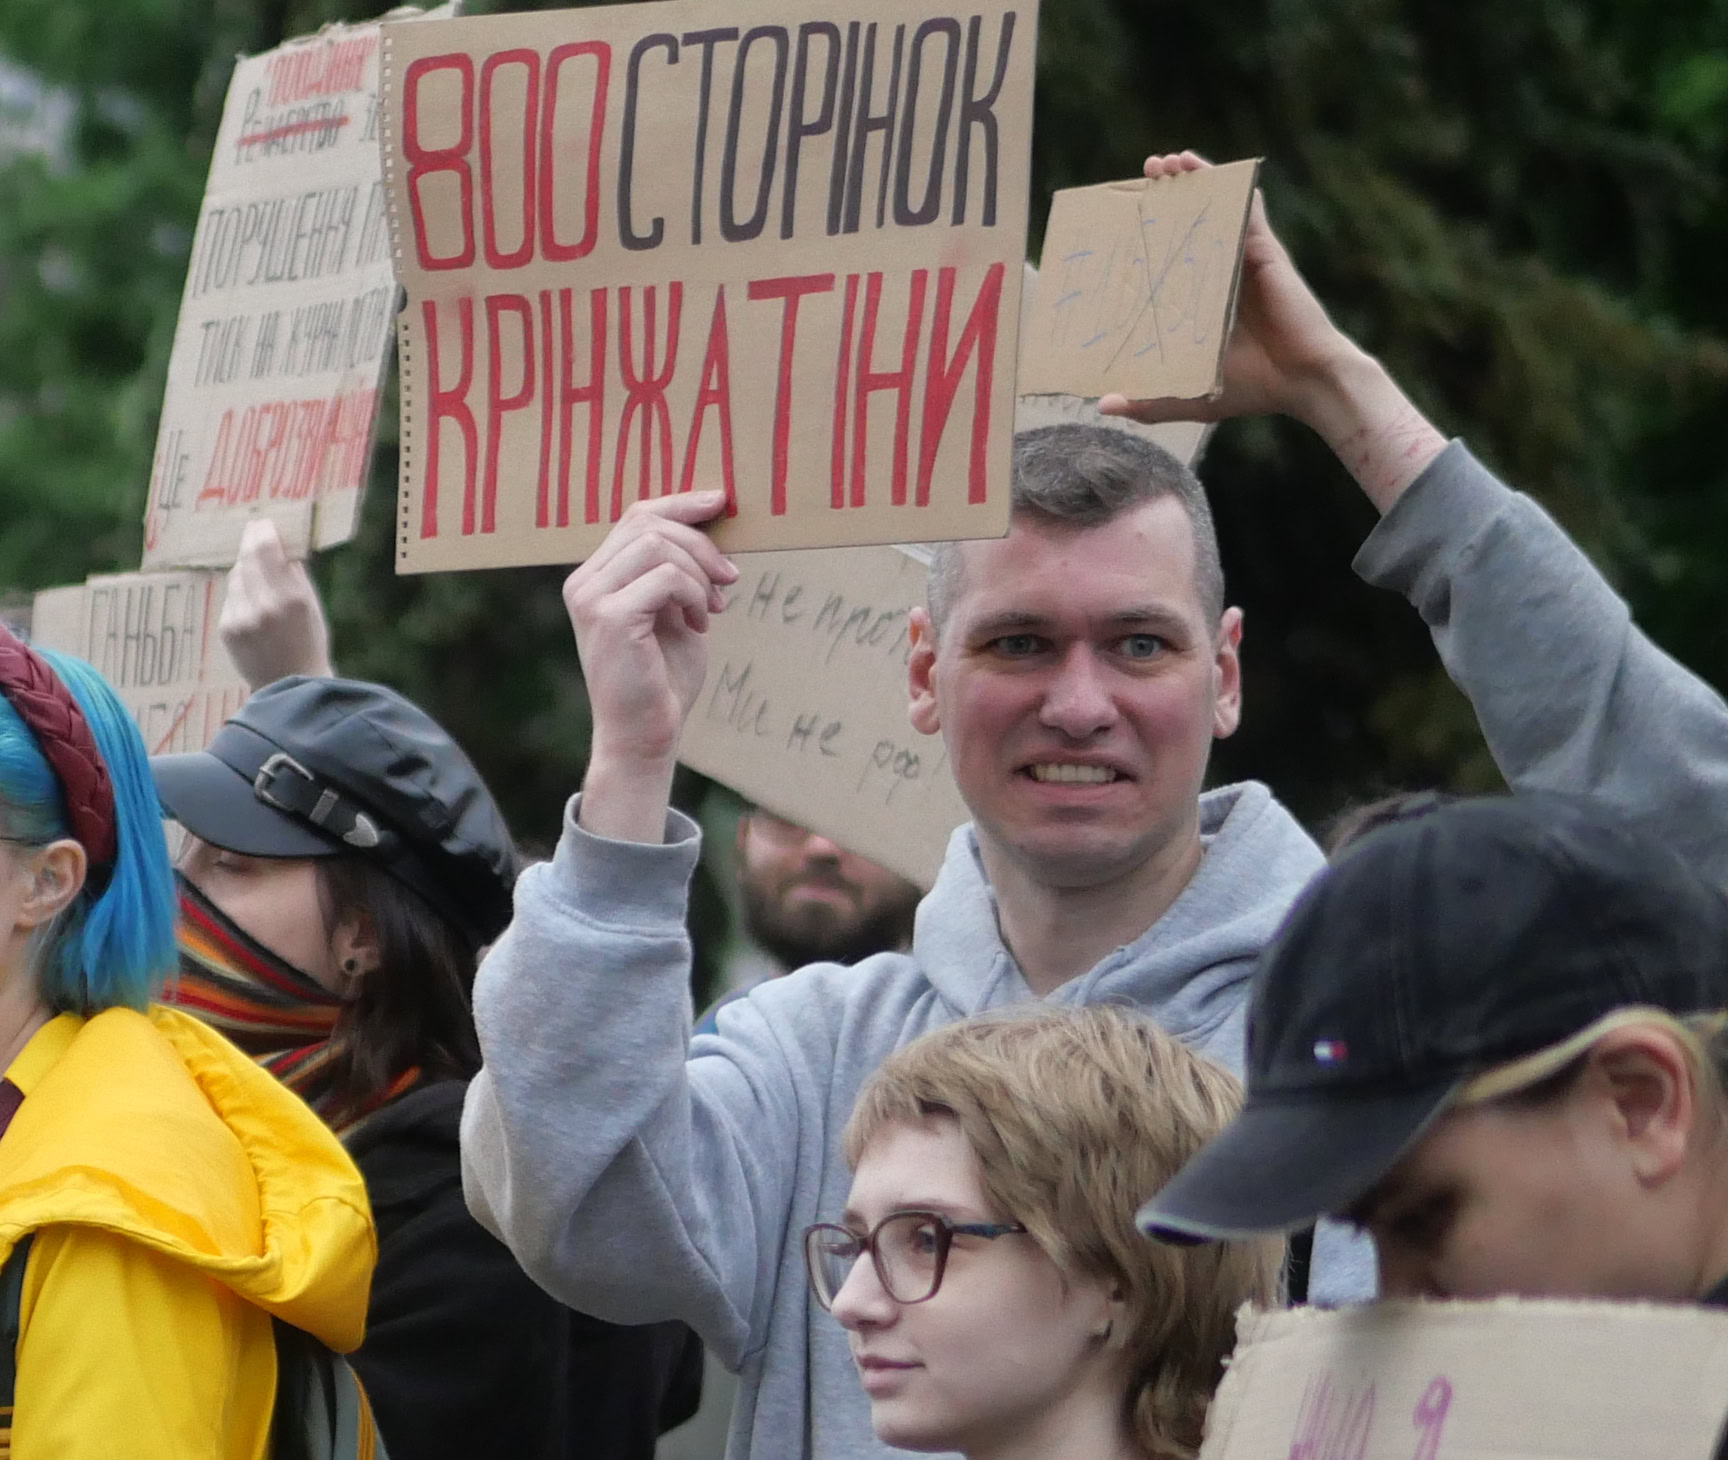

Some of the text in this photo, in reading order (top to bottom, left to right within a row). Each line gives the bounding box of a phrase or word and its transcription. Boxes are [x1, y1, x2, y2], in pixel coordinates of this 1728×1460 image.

[402, 10, 1017, 272] 800 СТОРІНОК
[419, 262, 1006, 539] КРІНЖАТІНИ
